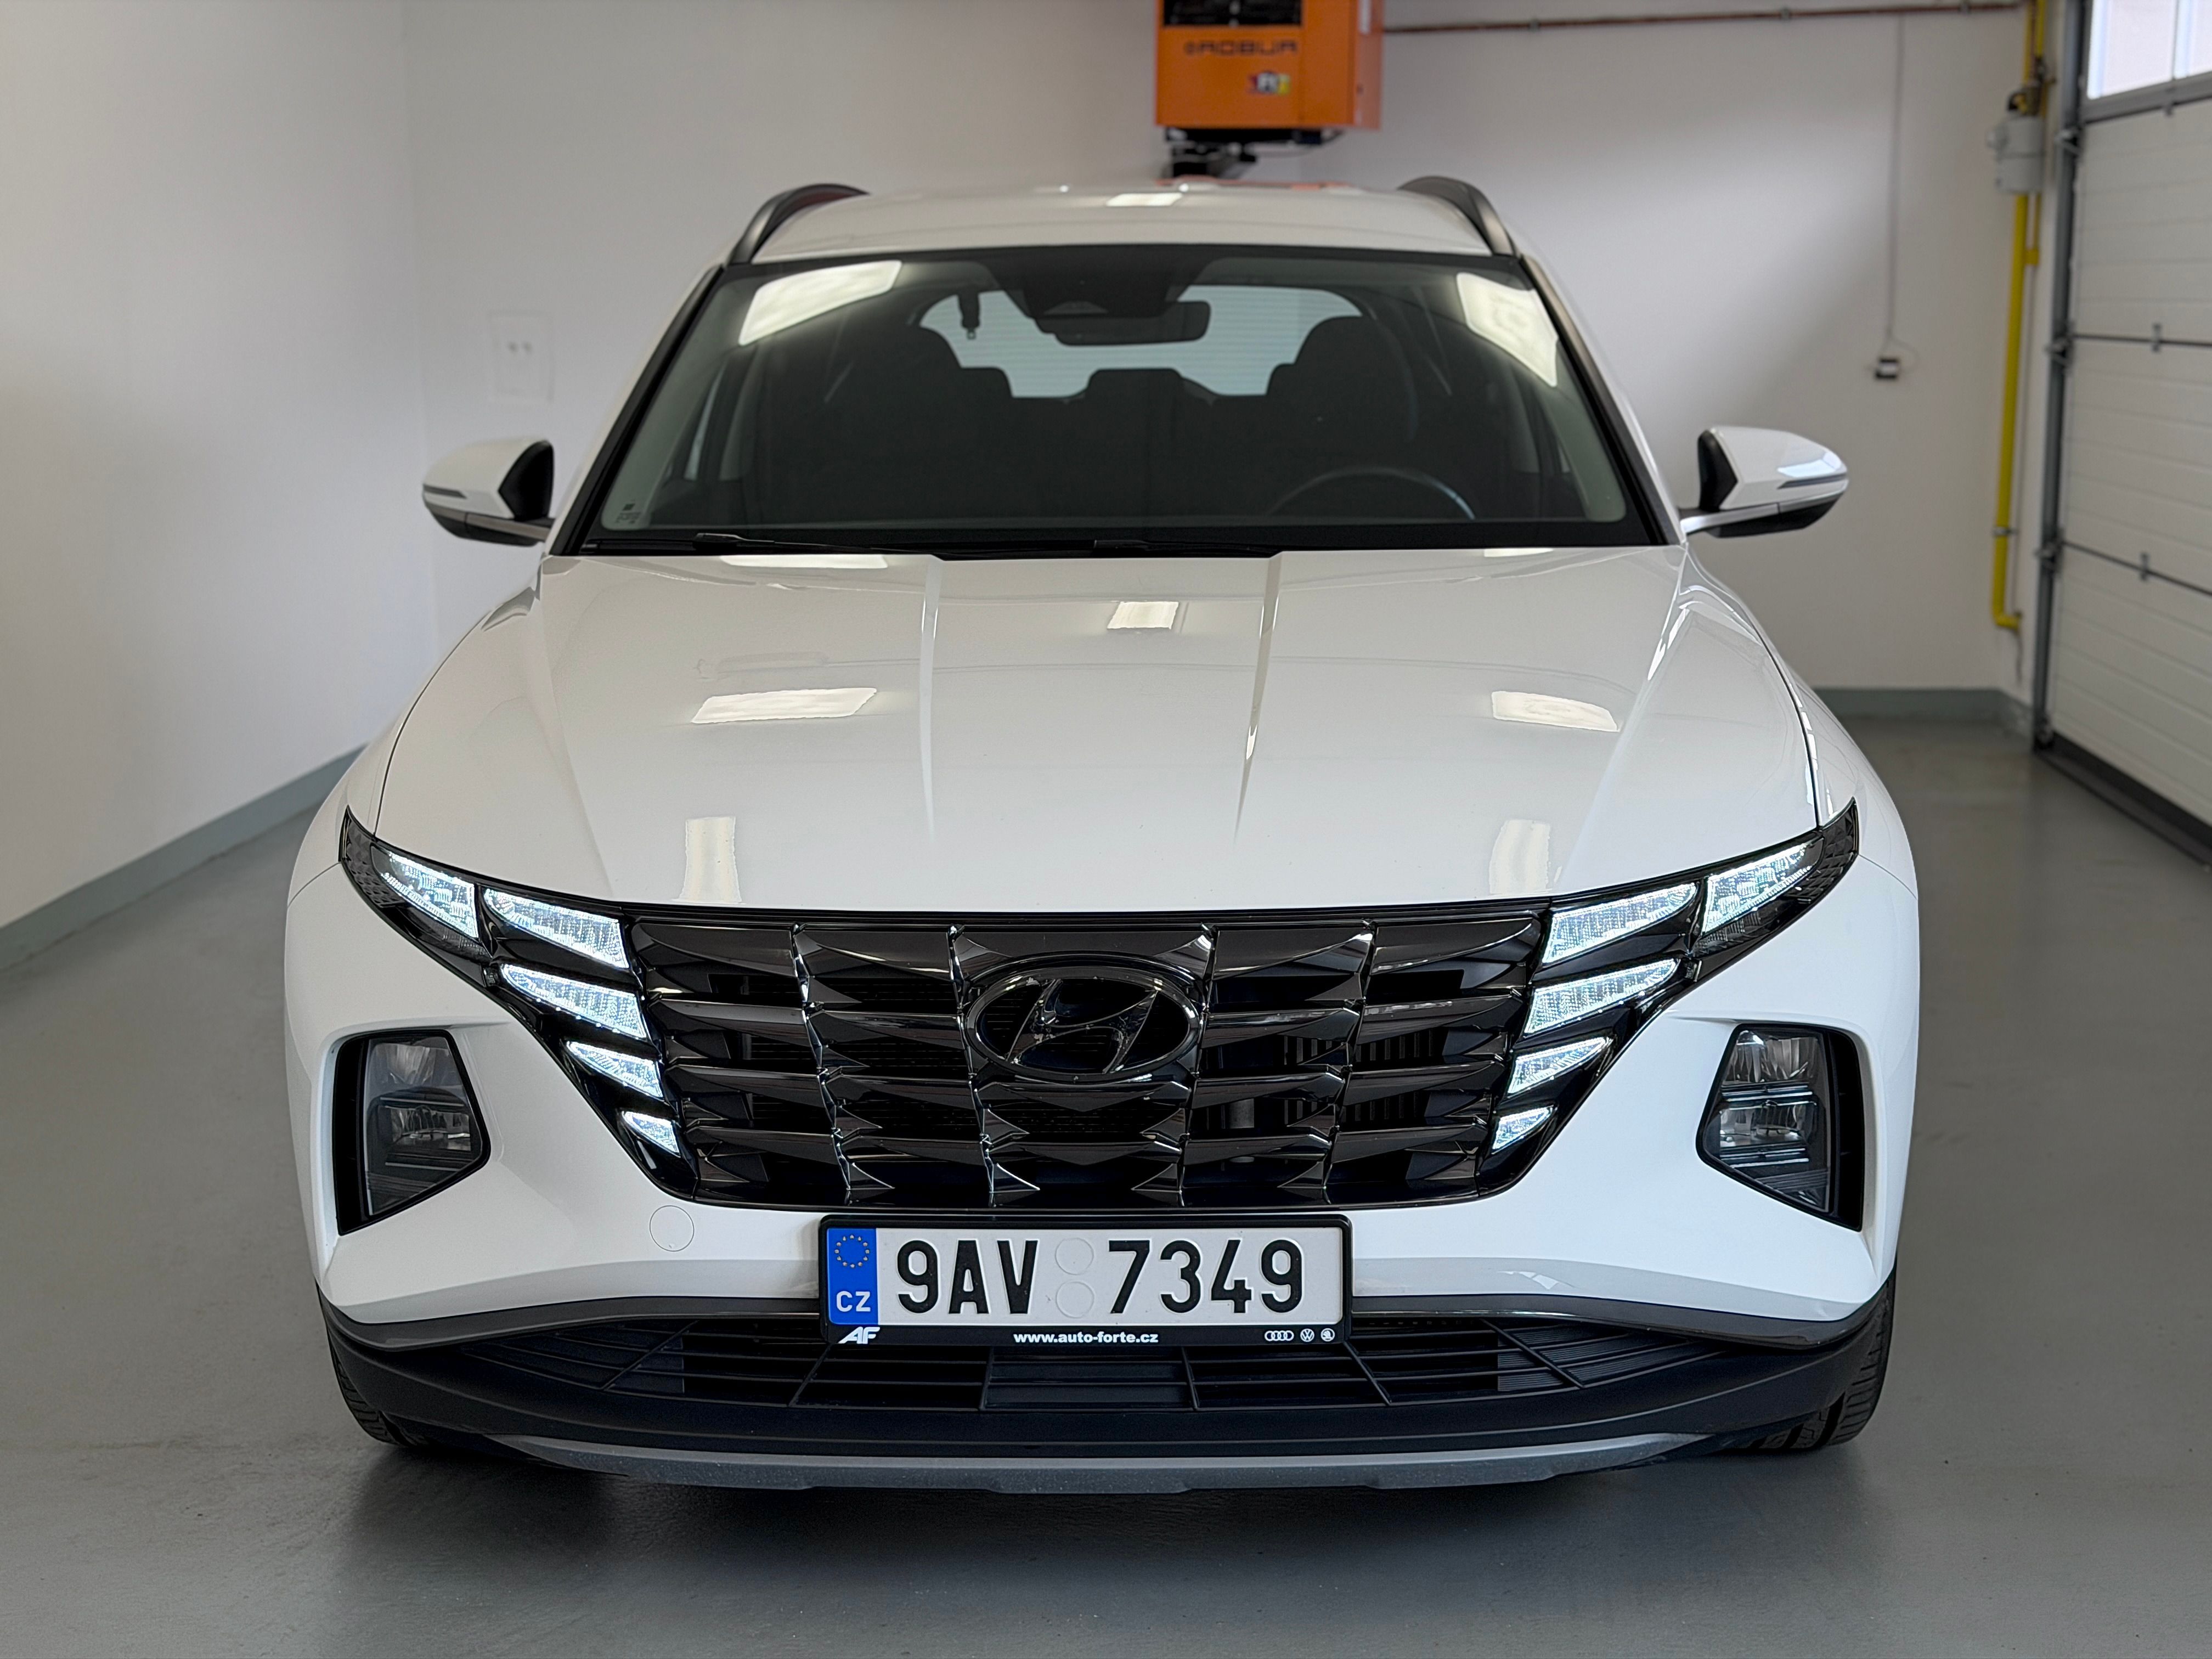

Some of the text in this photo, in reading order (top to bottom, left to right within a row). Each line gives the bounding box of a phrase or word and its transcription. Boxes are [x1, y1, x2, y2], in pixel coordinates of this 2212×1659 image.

[897, 1239, 1302, 1314] 9AV 7349
[836, 1290, 871, 1312] CZ
[838, 1326, 881, 1345] AF
[1013, 1331, 1159, 1343] www.auto-forte.cz
